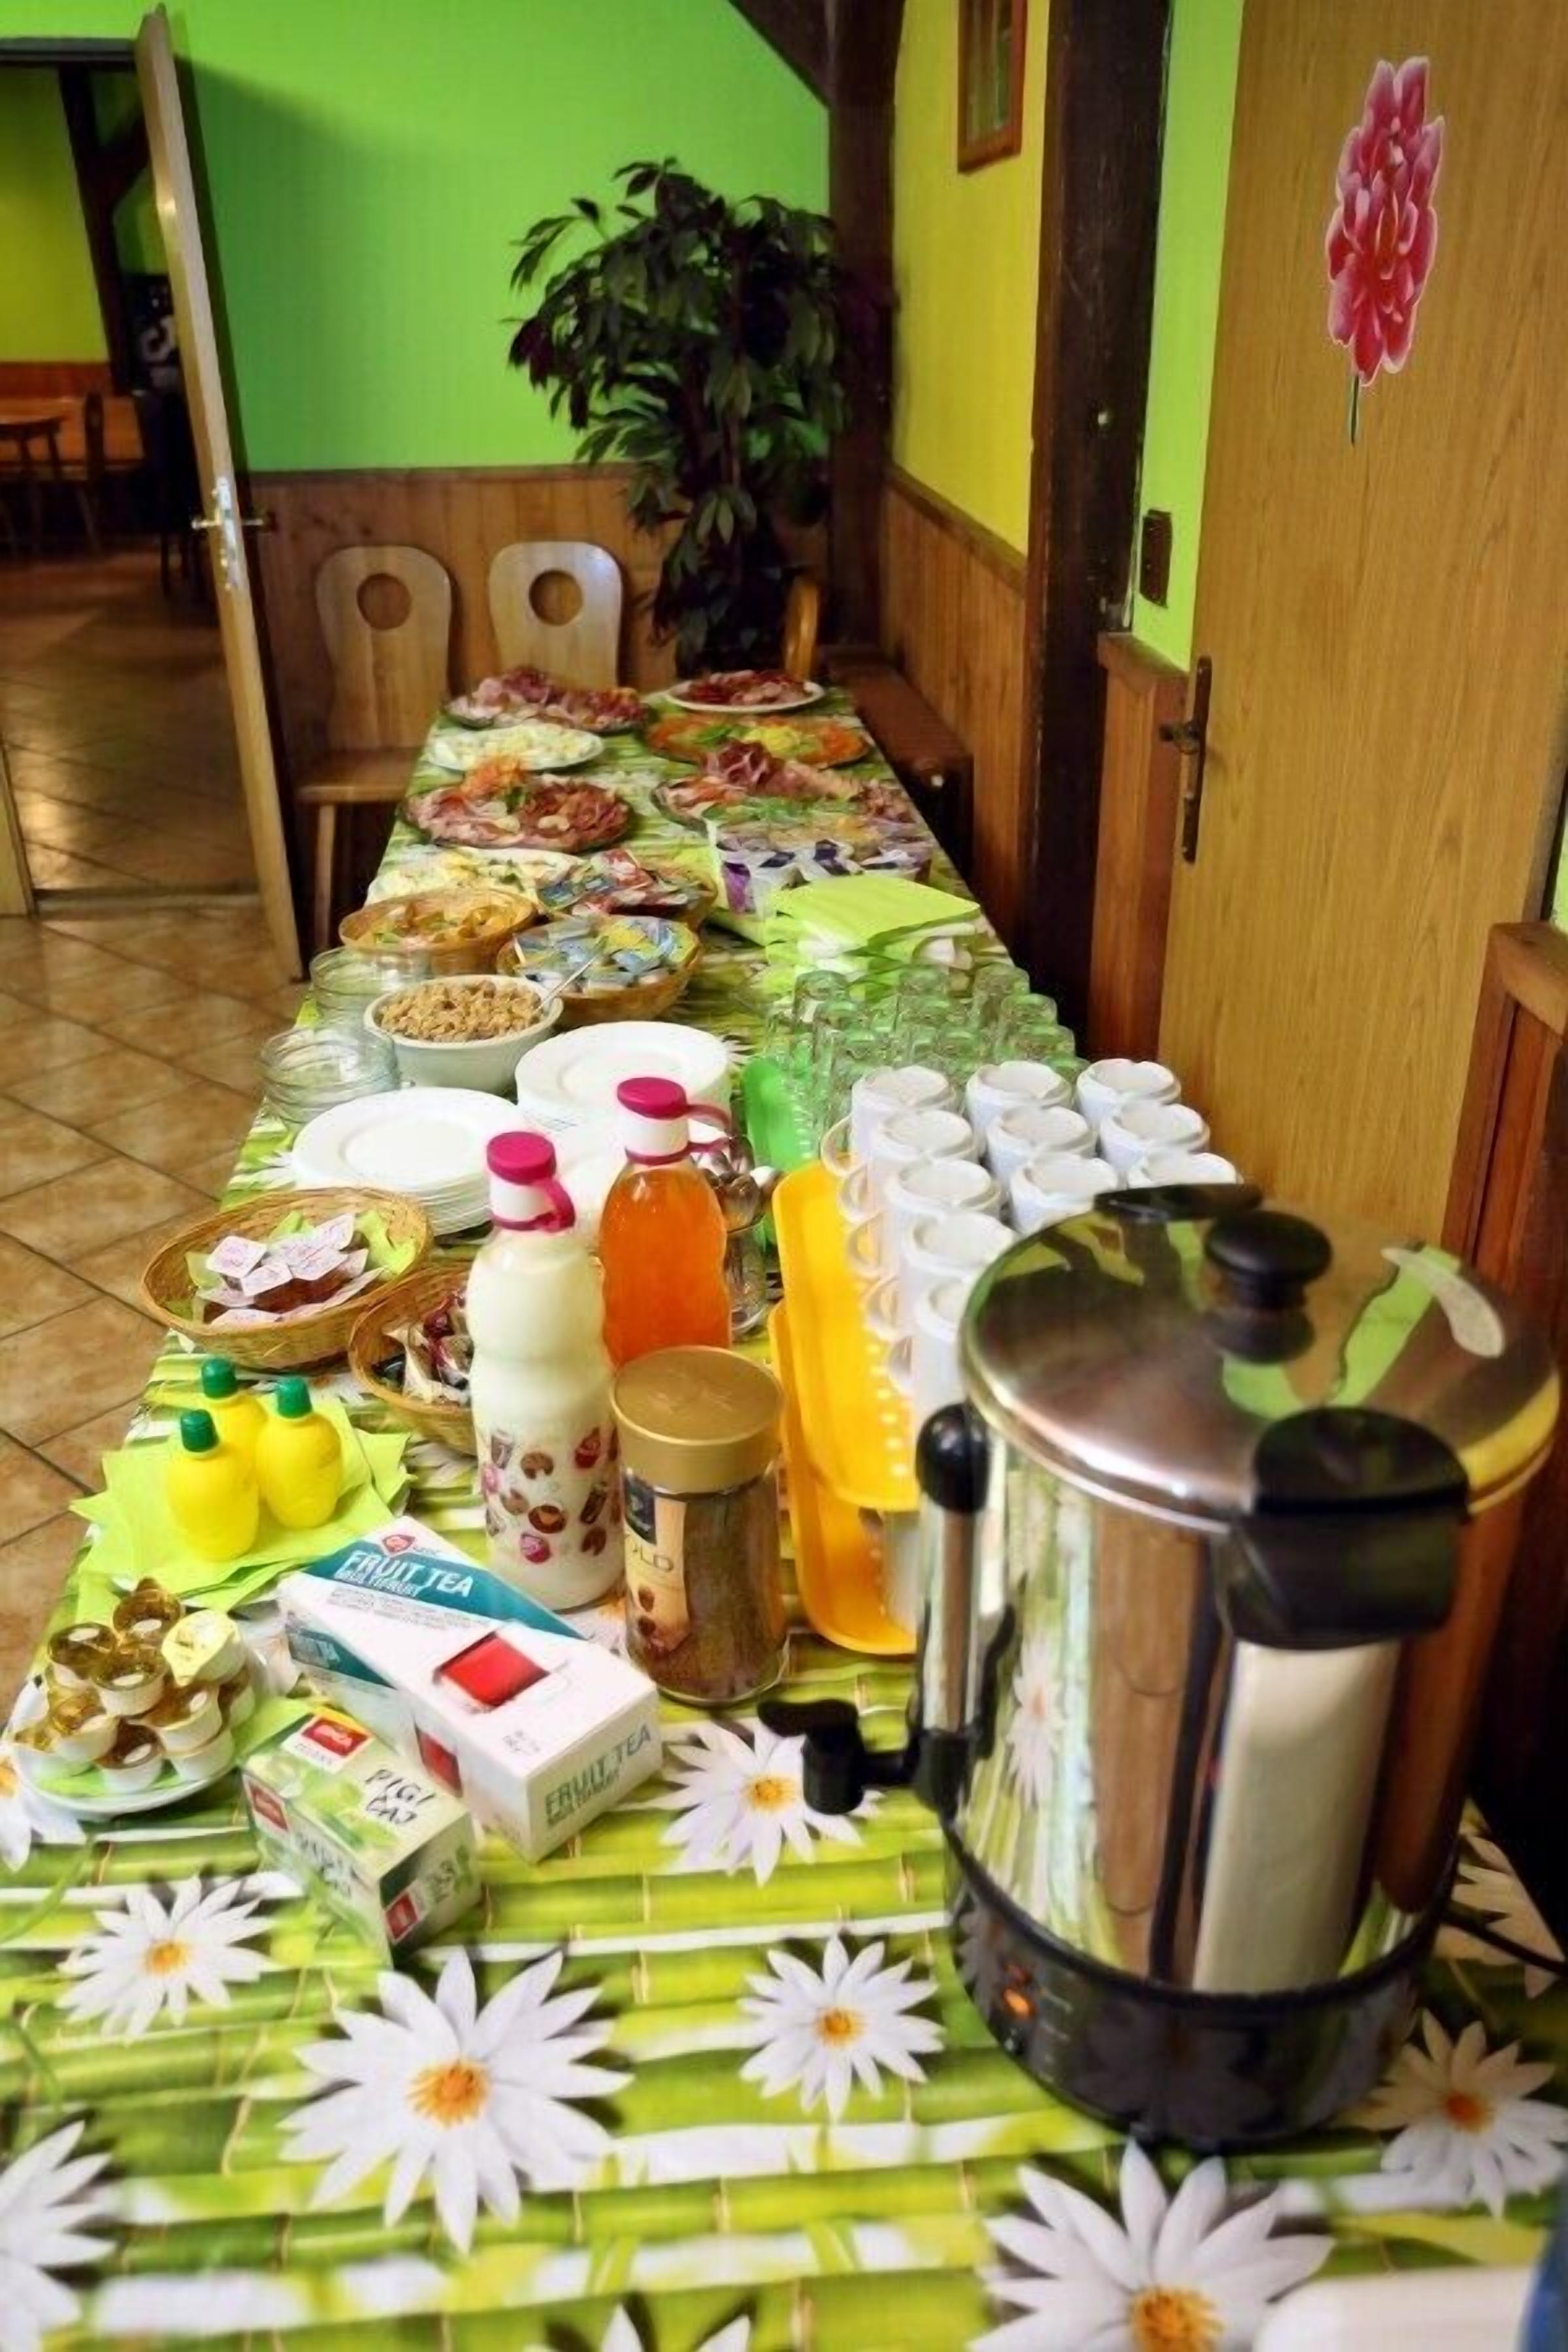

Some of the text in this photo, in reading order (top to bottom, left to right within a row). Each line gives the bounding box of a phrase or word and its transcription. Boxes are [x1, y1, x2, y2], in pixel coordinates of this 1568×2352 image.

[335, 1550, 427, 1585] FRUIT
[423, 1567, 474, 1597] TEA
[545, 1754, 608, 1819] FRUIT
[612, 1723, 651, 1764] TEA
